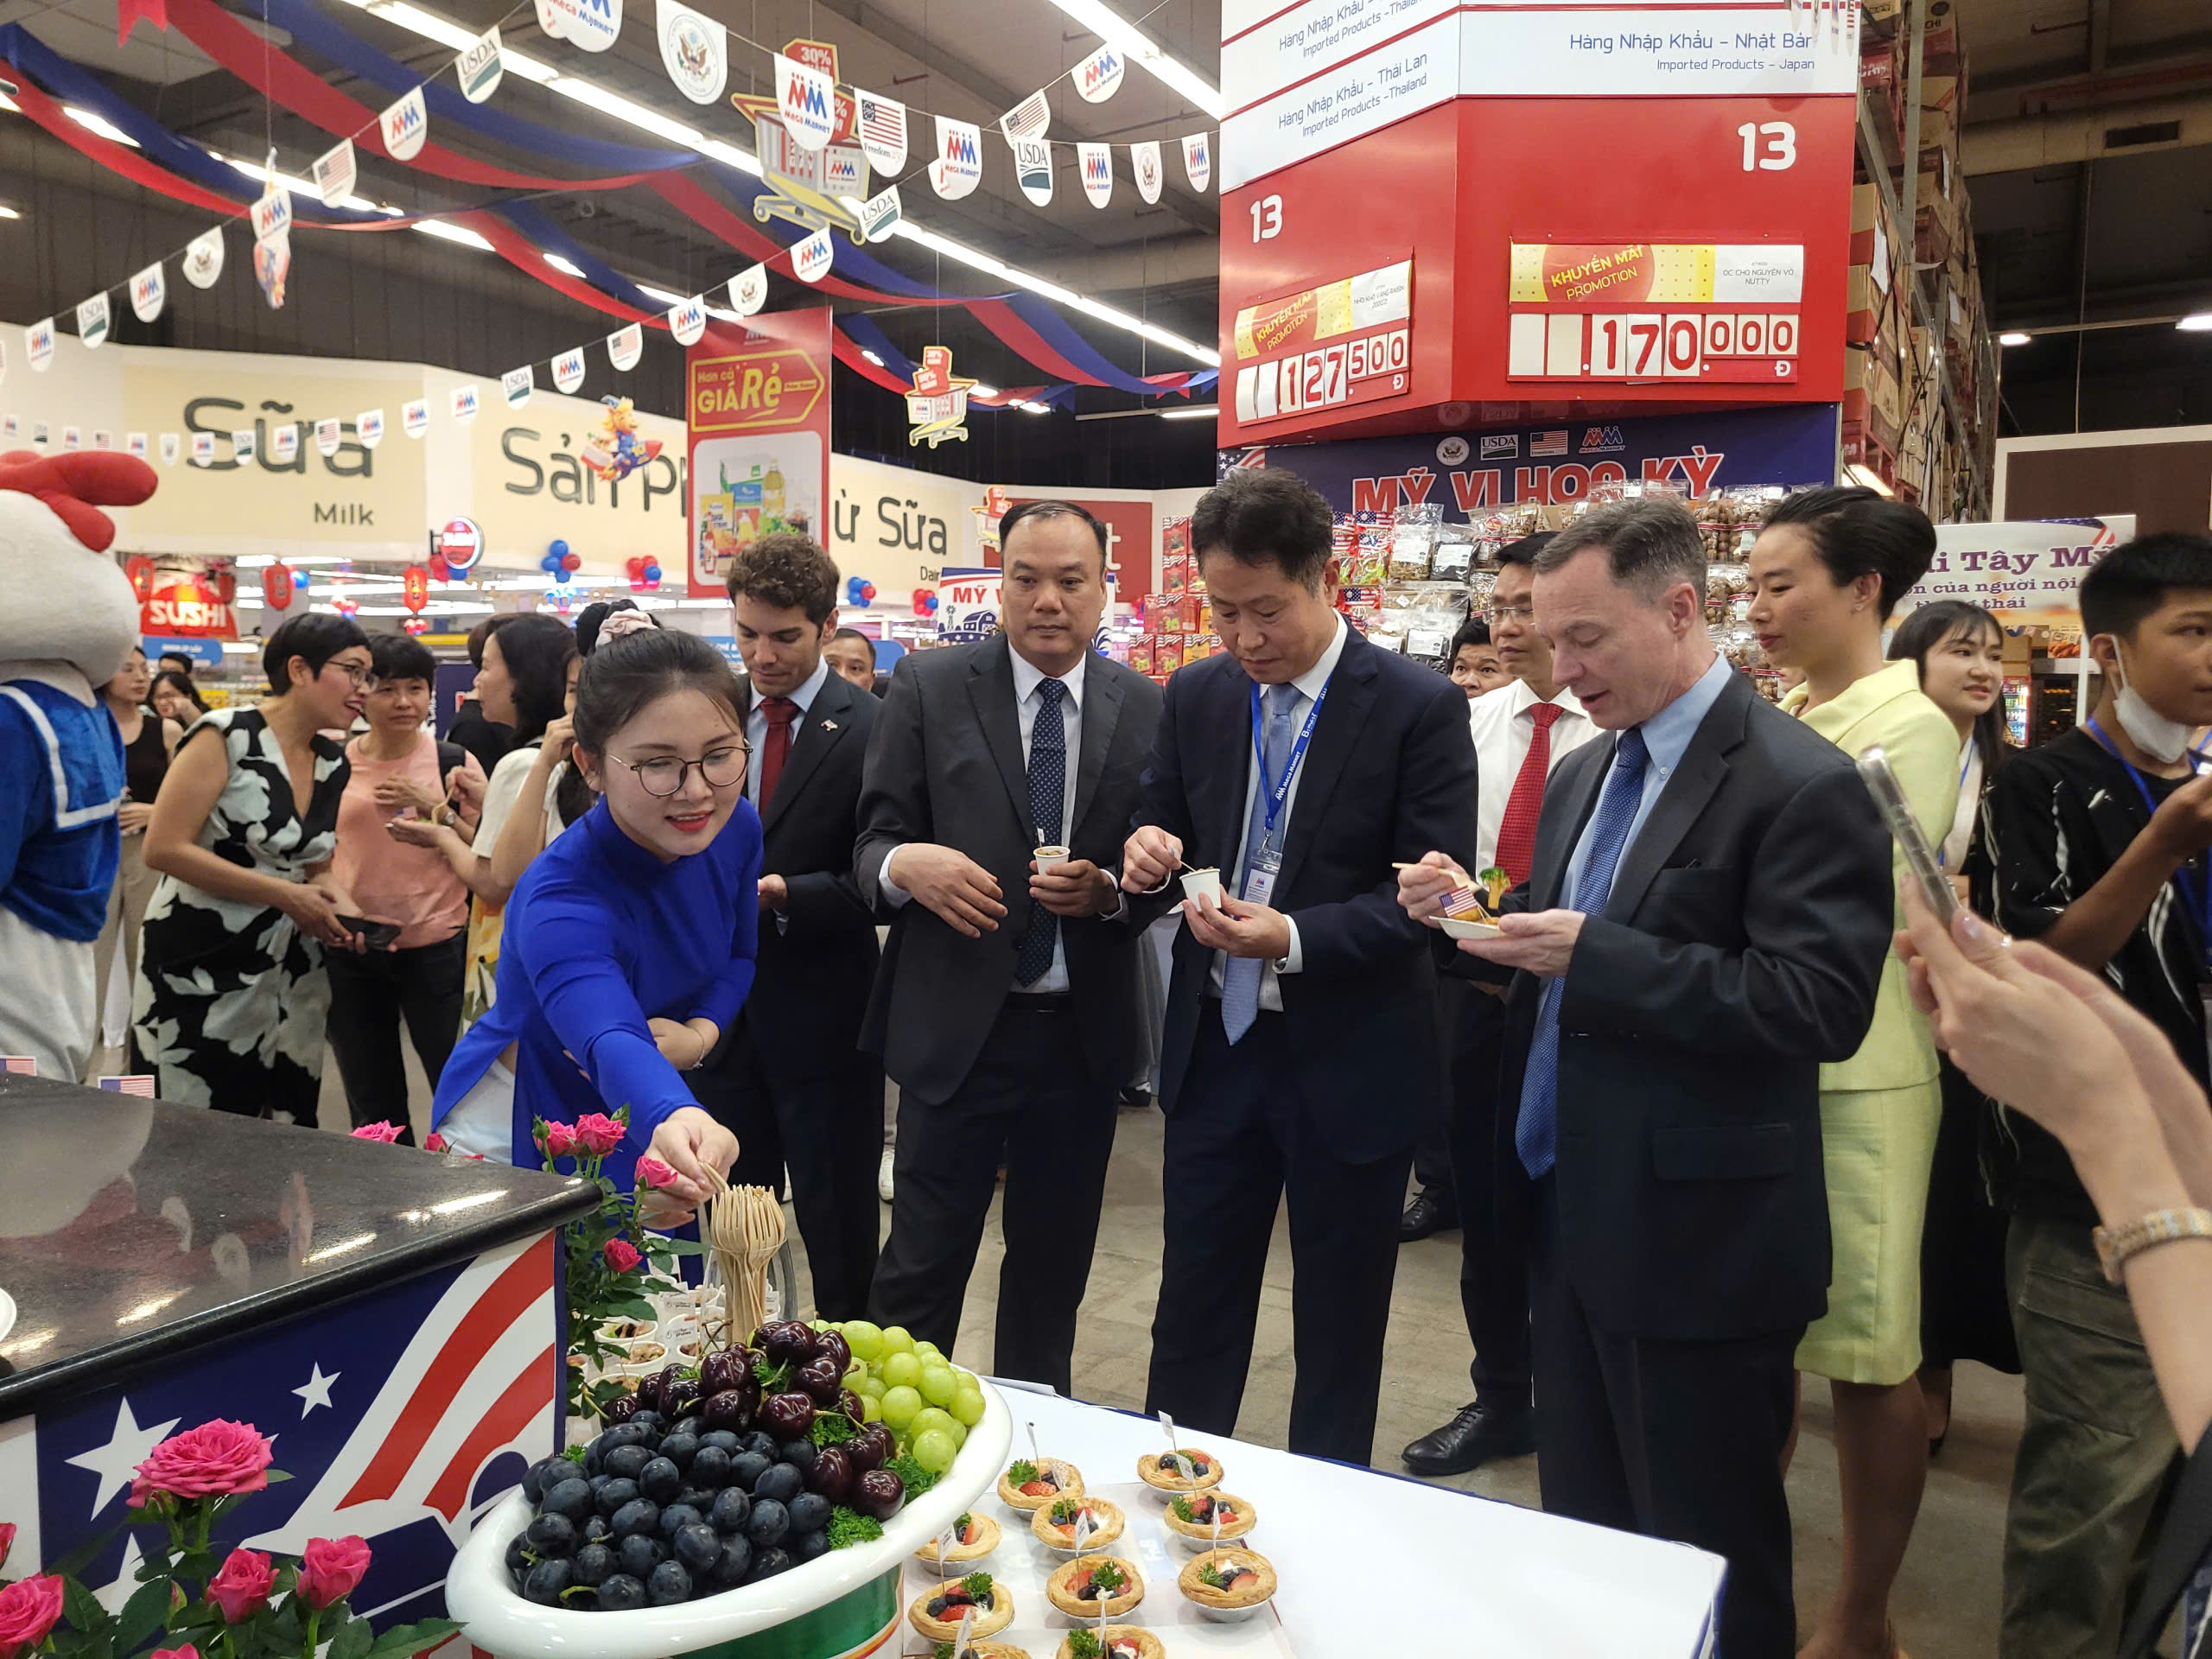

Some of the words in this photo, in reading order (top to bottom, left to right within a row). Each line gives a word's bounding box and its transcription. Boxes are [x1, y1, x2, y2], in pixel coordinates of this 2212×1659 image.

[1279, 30, 1304, 51] Hàng
[1303, 32, 1339, 57] Imported
[1342, 11, 1382, 39] Products
[1570, 33, 1612, 54] Hàng
[1620, 33, 1662, 54] Nhập
[1669, 29, 1713, 49] Khẩu
[1735, 33, 1776, 51] Nhật
[460, 38, 498, 77] USDA
[802, 47, 831, 67] 30%
[1656, 59, 1708, 71] Imported
[1712, 59, 1764, 70] Products
[1779, 59, 1815, 73] Japan
[1279, 109, 1304, 129] Hàng
[1307, 96, 1333, 118] Nhập
[1405, 54, 1427, 73] Lan
[1303, 112, 1339, 137] Imported
[1341, 96, 1381, 120] Products
[1018, 142, 1048, 166] USDA
[1738, 121, 1796, 171] 13
[861, 194, 895, 221] USDA
[1249, 194, 1284, 243] 13
[1566, 267, 1637, 301] PROMOTION
[1267, 311, 1308, 351] PROMOTION
[697, 381, 740, 414] GIÁ
[1482, 436, 1516, 448] USDA
[1352, 467, 1437, 512] MỸ
[1641, 445, 1725, 500] KỲ
[315, 503, 373, 525] Milk
[835, 488, 861, 543] ừ
[878, 496, 946, 555] Sữa
[919, 566, 939, 582] Dair
[1961, 550, 2039, 575] Tây
[953, 584, 987, 604] MỸ
[1933, 582, 1969, 594] của
[1975, 578, 2036, 594] người
[2042, 576, 2079, 591] nội
[149, 600, 226, 627] SUSHI
[1983, 597, 2026, 610] thái
